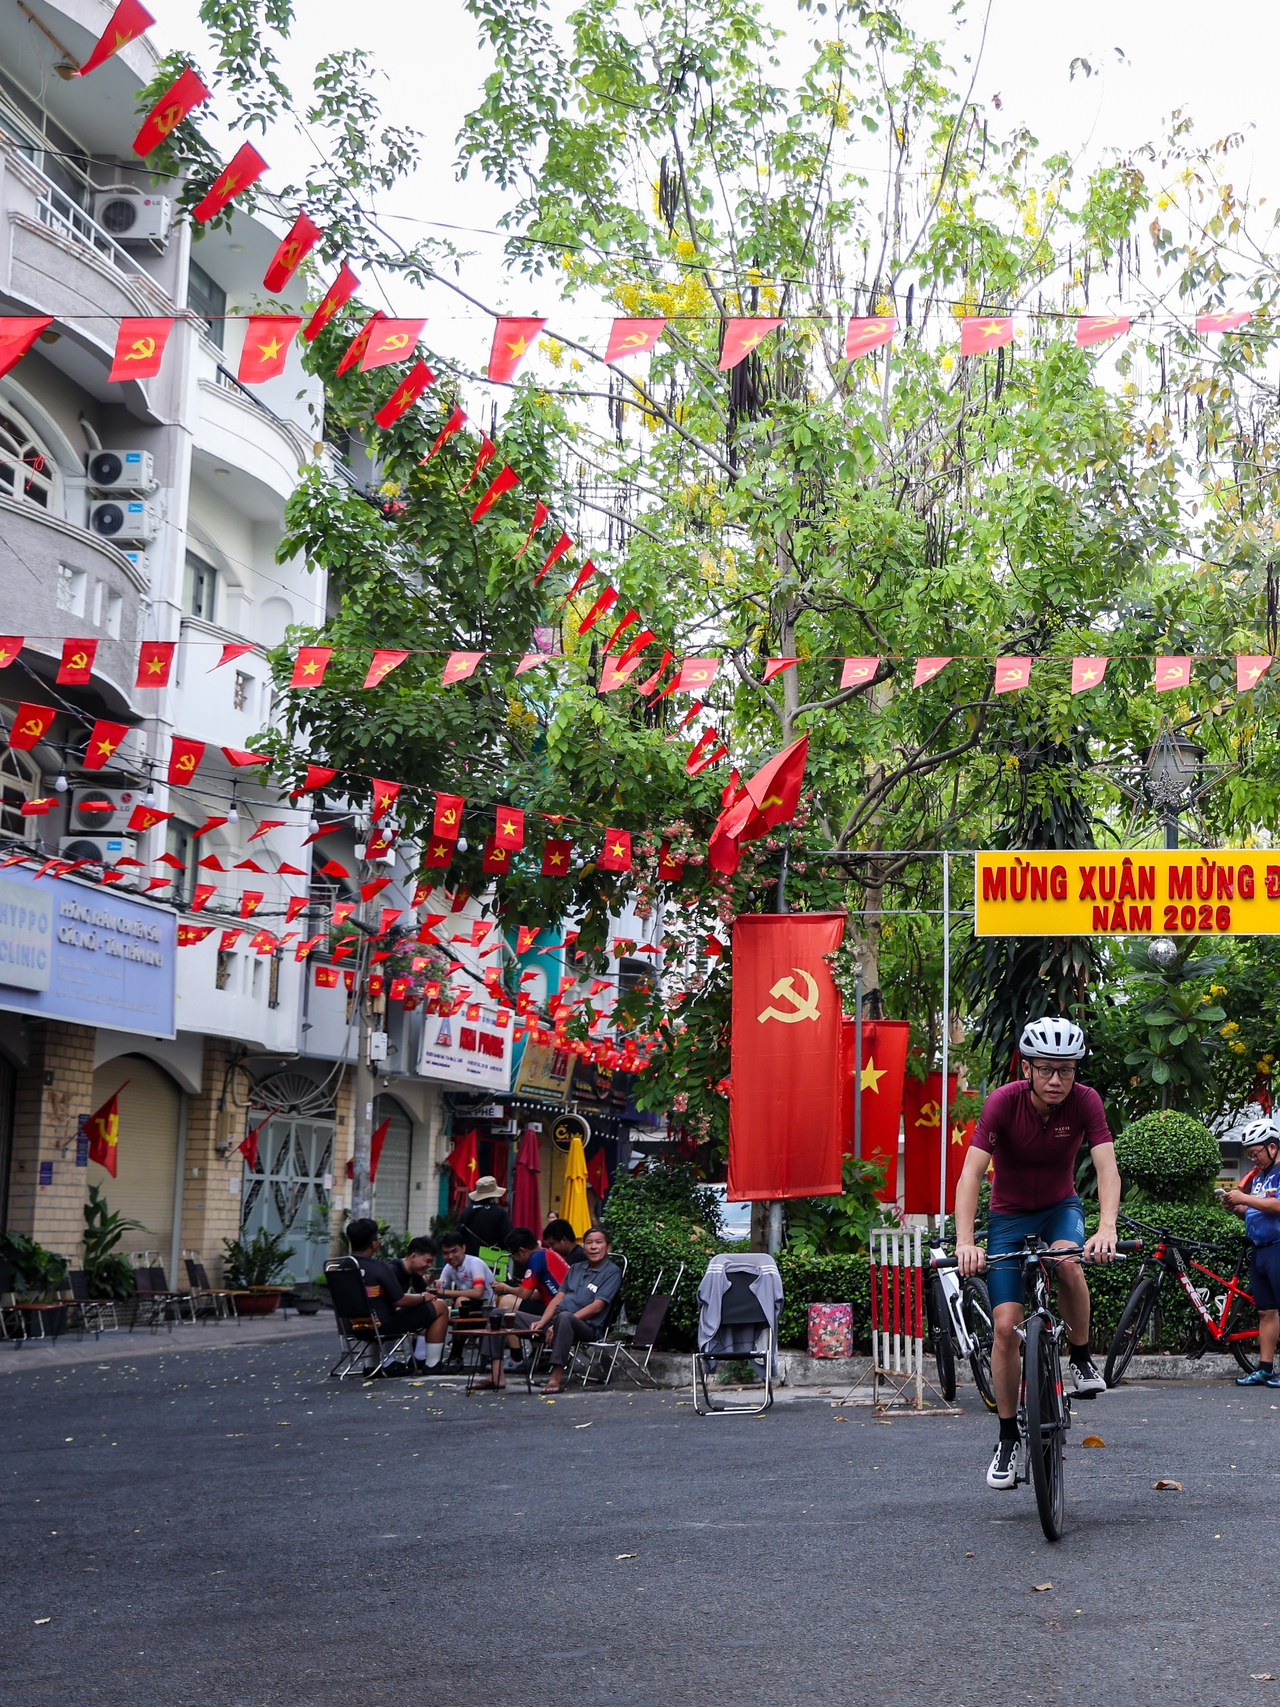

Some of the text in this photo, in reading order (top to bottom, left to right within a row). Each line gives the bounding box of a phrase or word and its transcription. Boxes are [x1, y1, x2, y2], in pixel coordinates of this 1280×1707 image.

[982, 857, 1067, 900] MỪNG
[1079, 857, 1155, 900] XUÂN
[1168, 857, 1254, 900] MỪNG
[0, 902, 48, 934] HYPPO
[1092, 900, 1152, 930] NĂM
[1164, 904, 1231, 930] 2026
[0, 939, 47, 970] CLINIC
[475, 1107, 495, 1117] PHÊ
